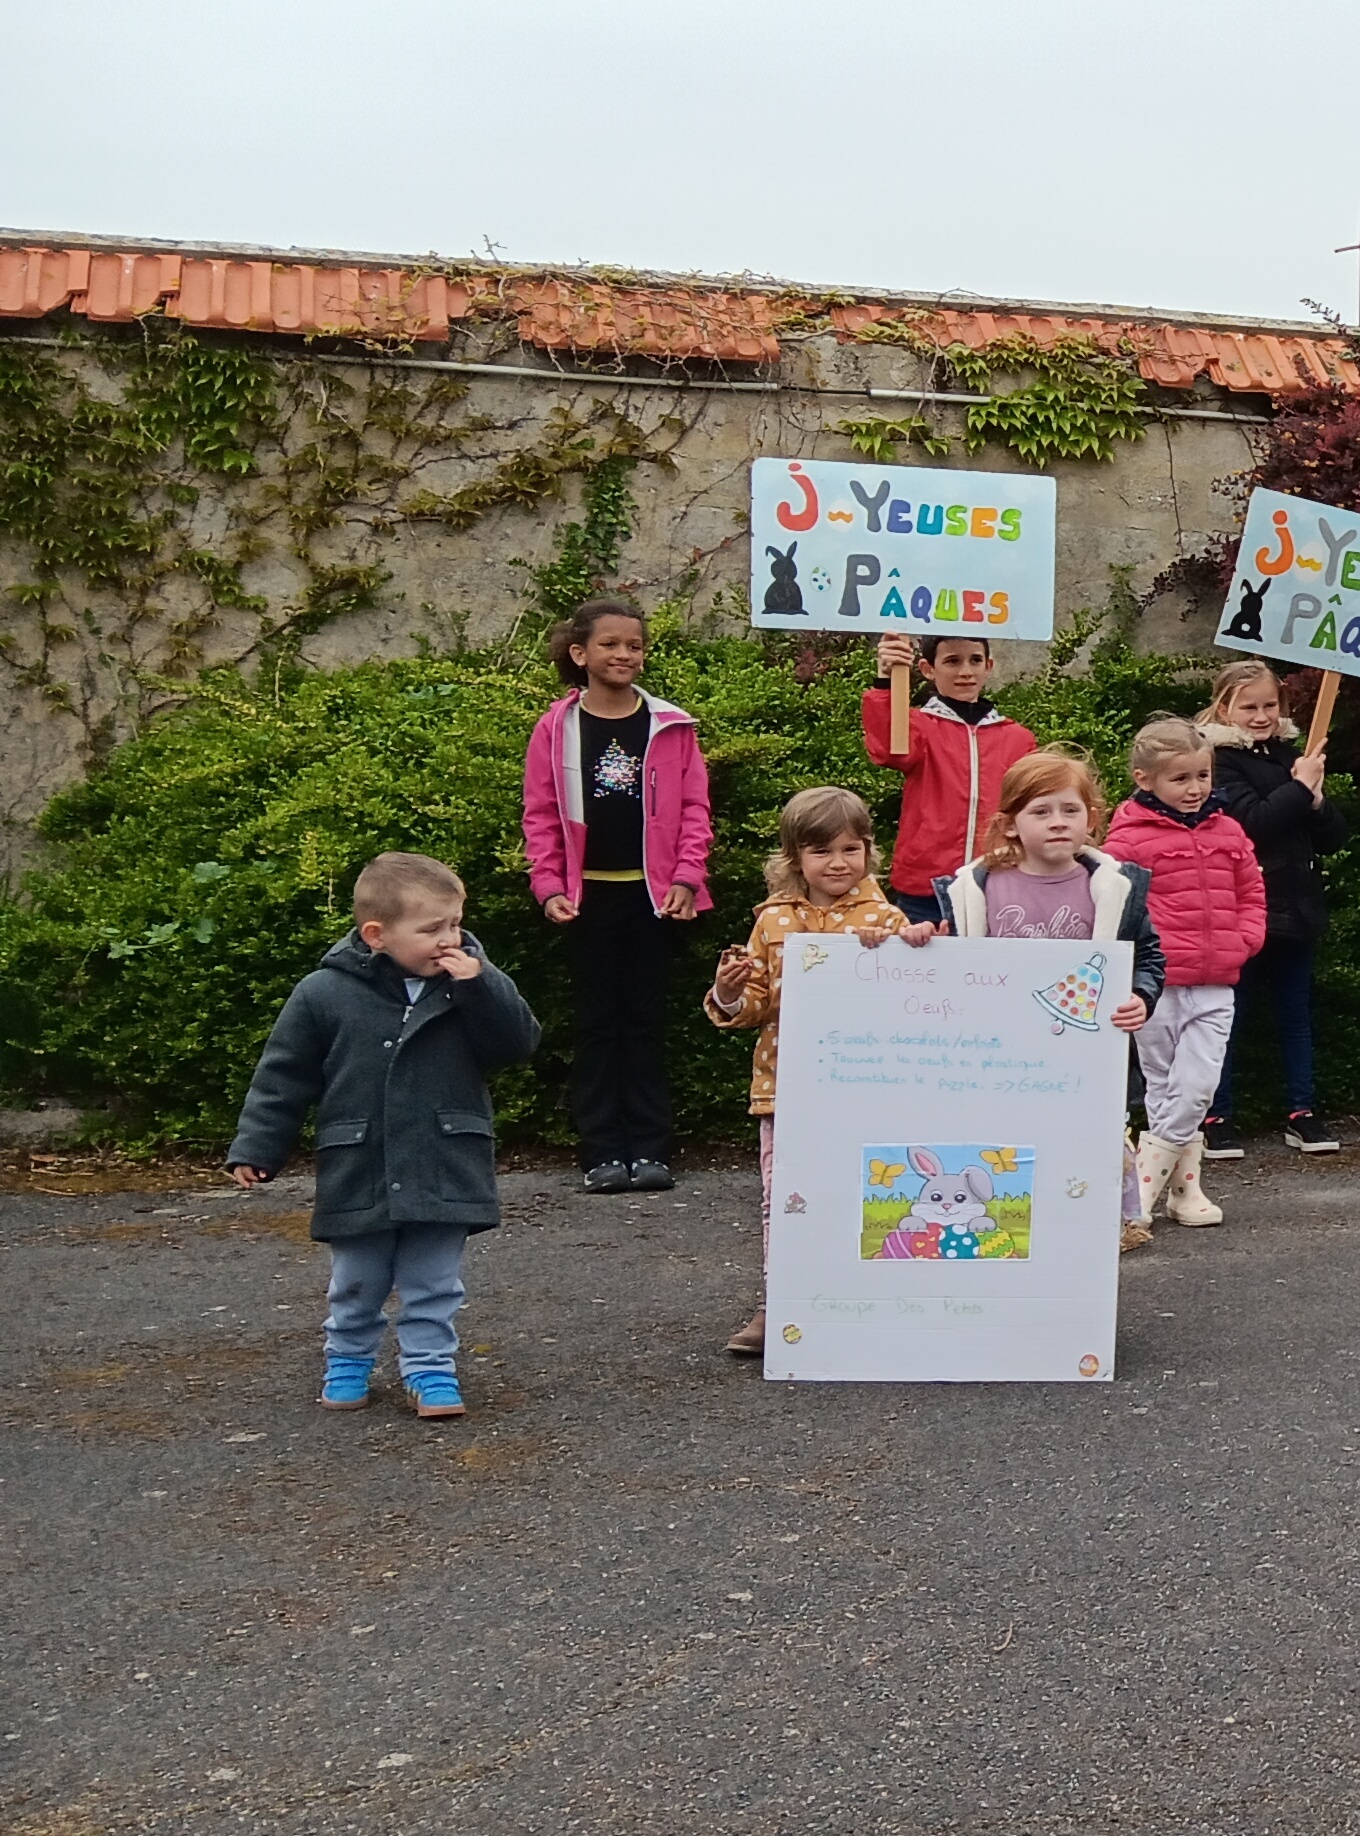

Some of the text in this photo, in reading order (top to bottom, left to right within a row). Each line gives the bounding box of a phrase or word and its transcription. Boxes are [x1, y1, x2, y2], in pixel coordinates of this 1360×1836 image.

[838, 553, 1009, 624] PÂQUES
[855, 950, 1010, 987] Chasse aux
